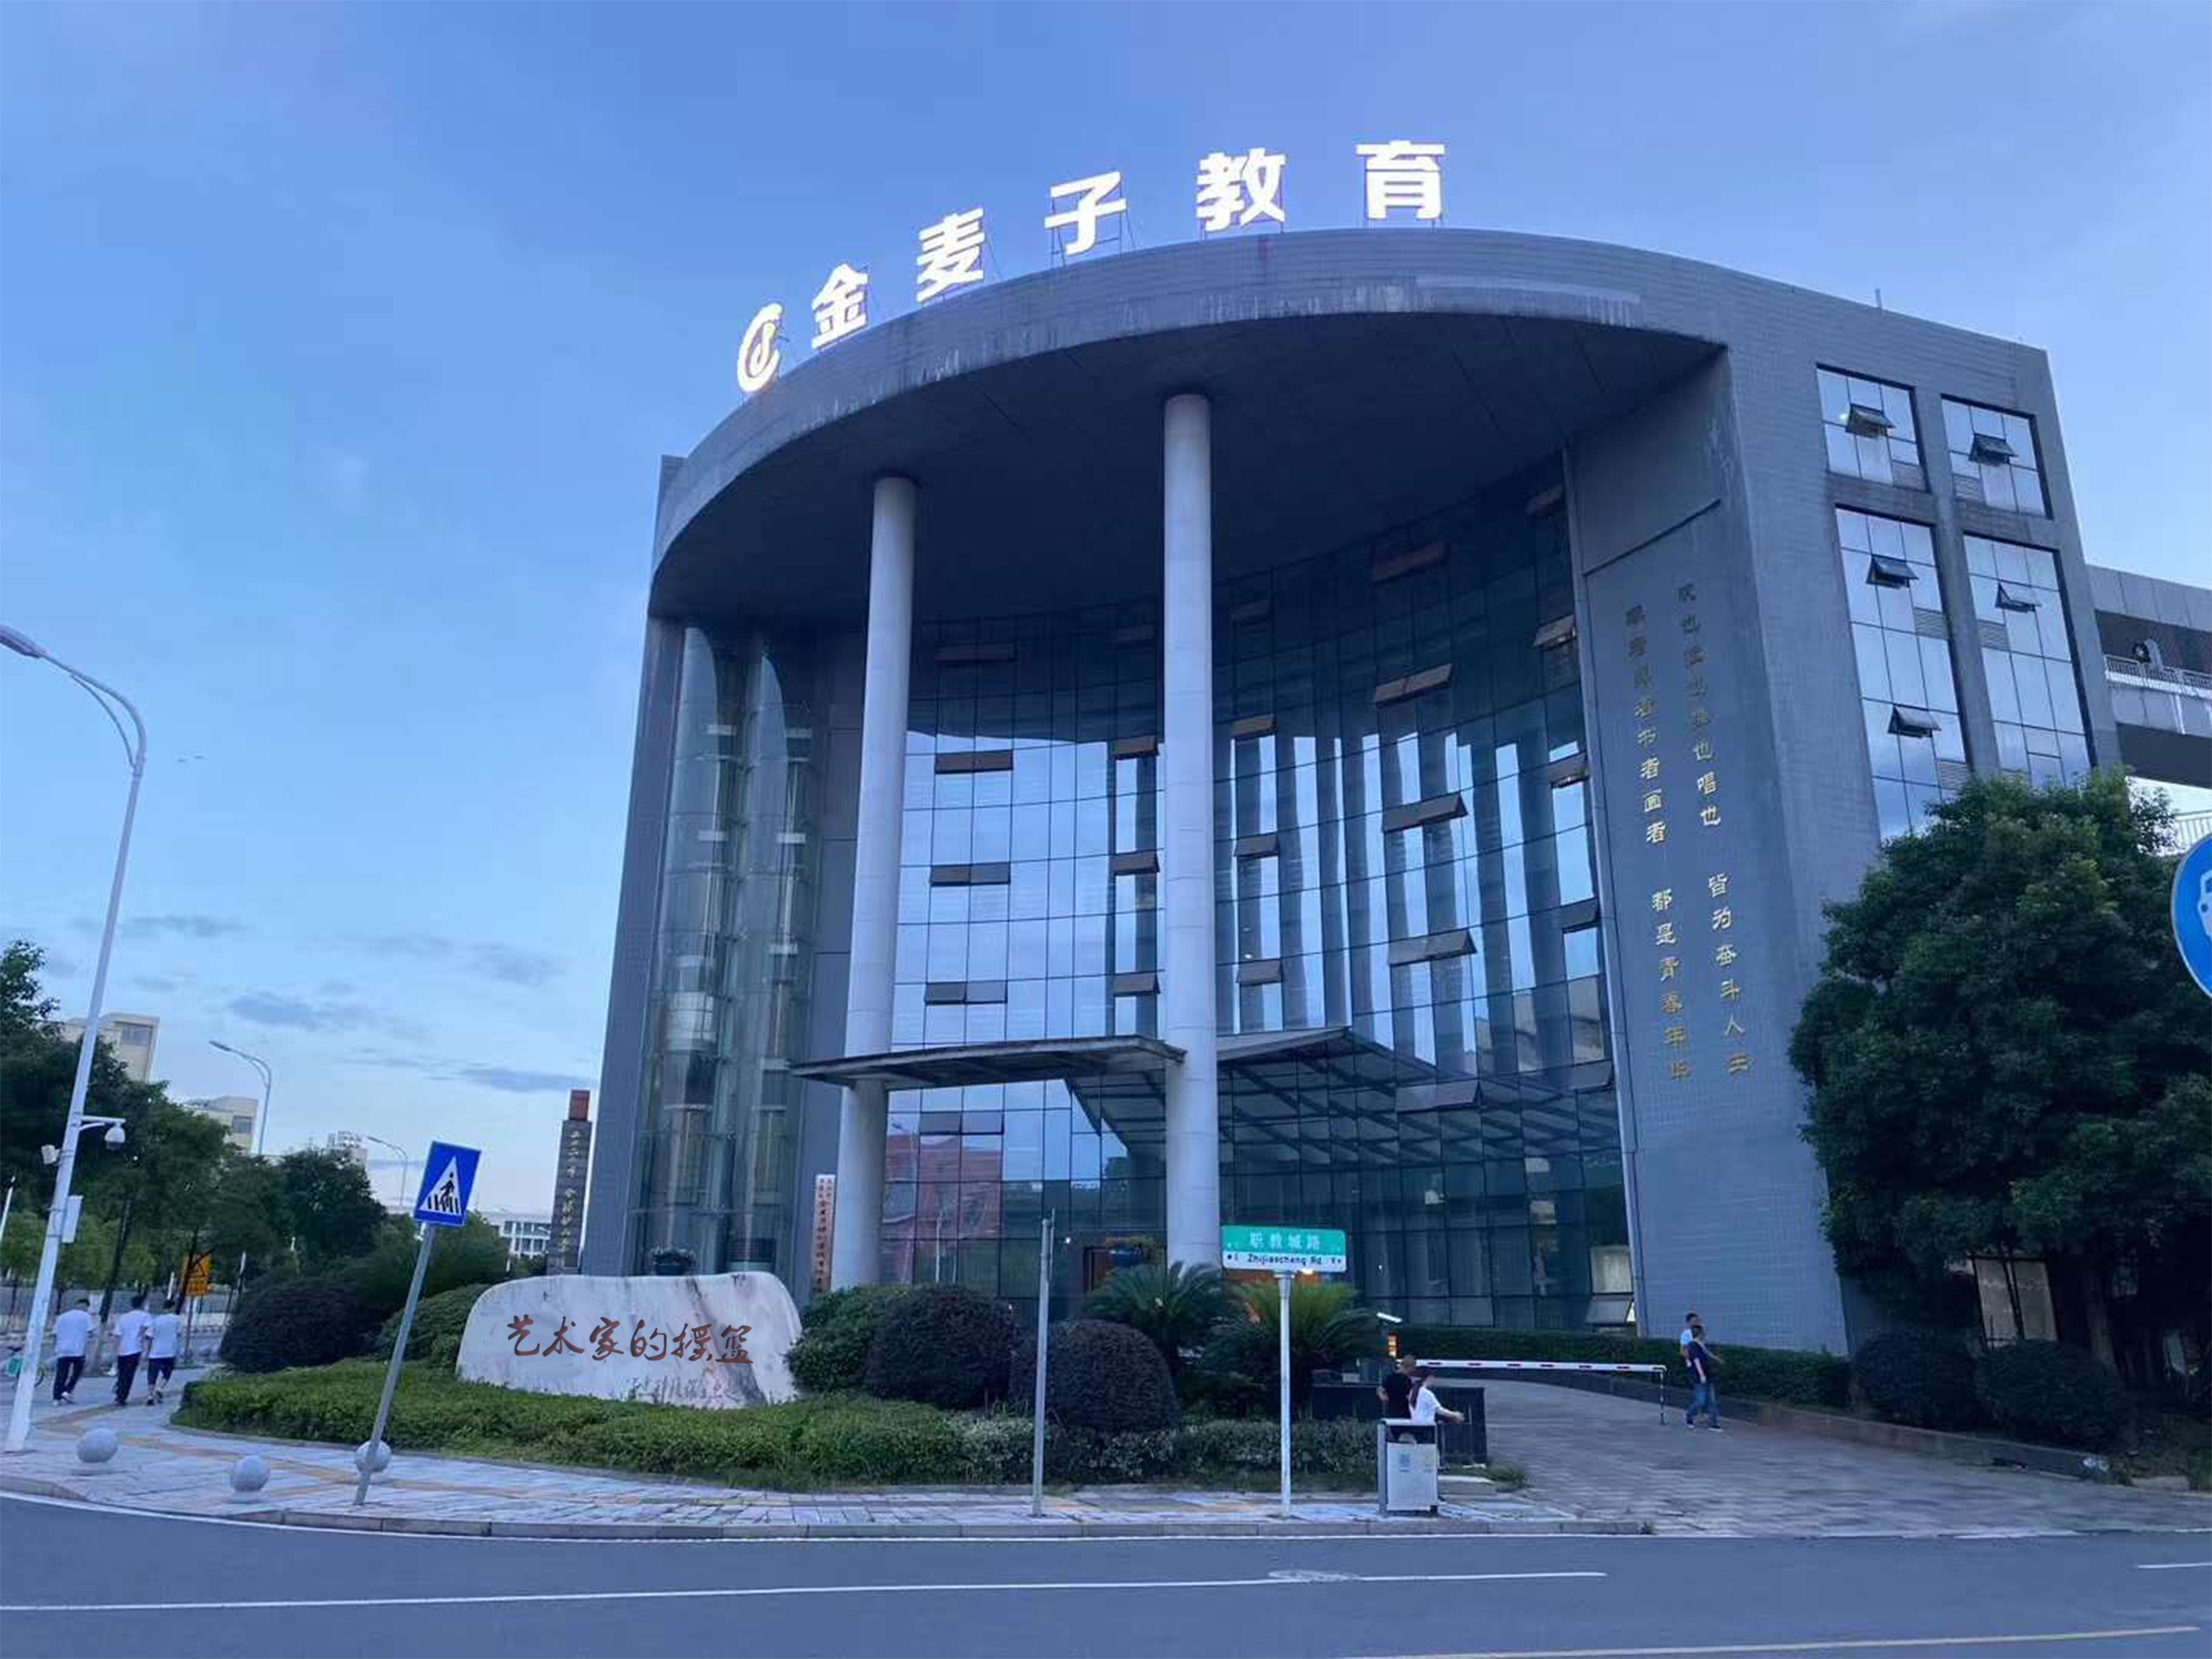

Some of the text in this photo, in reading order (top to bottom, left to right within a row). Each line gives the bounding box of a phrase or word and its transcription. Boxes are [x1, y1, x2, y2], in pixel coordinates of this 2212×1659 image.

[812, 139, 1445, 351] 金麦子教育
[507, 1314, 754, 1364] 艺术家的摇篮
